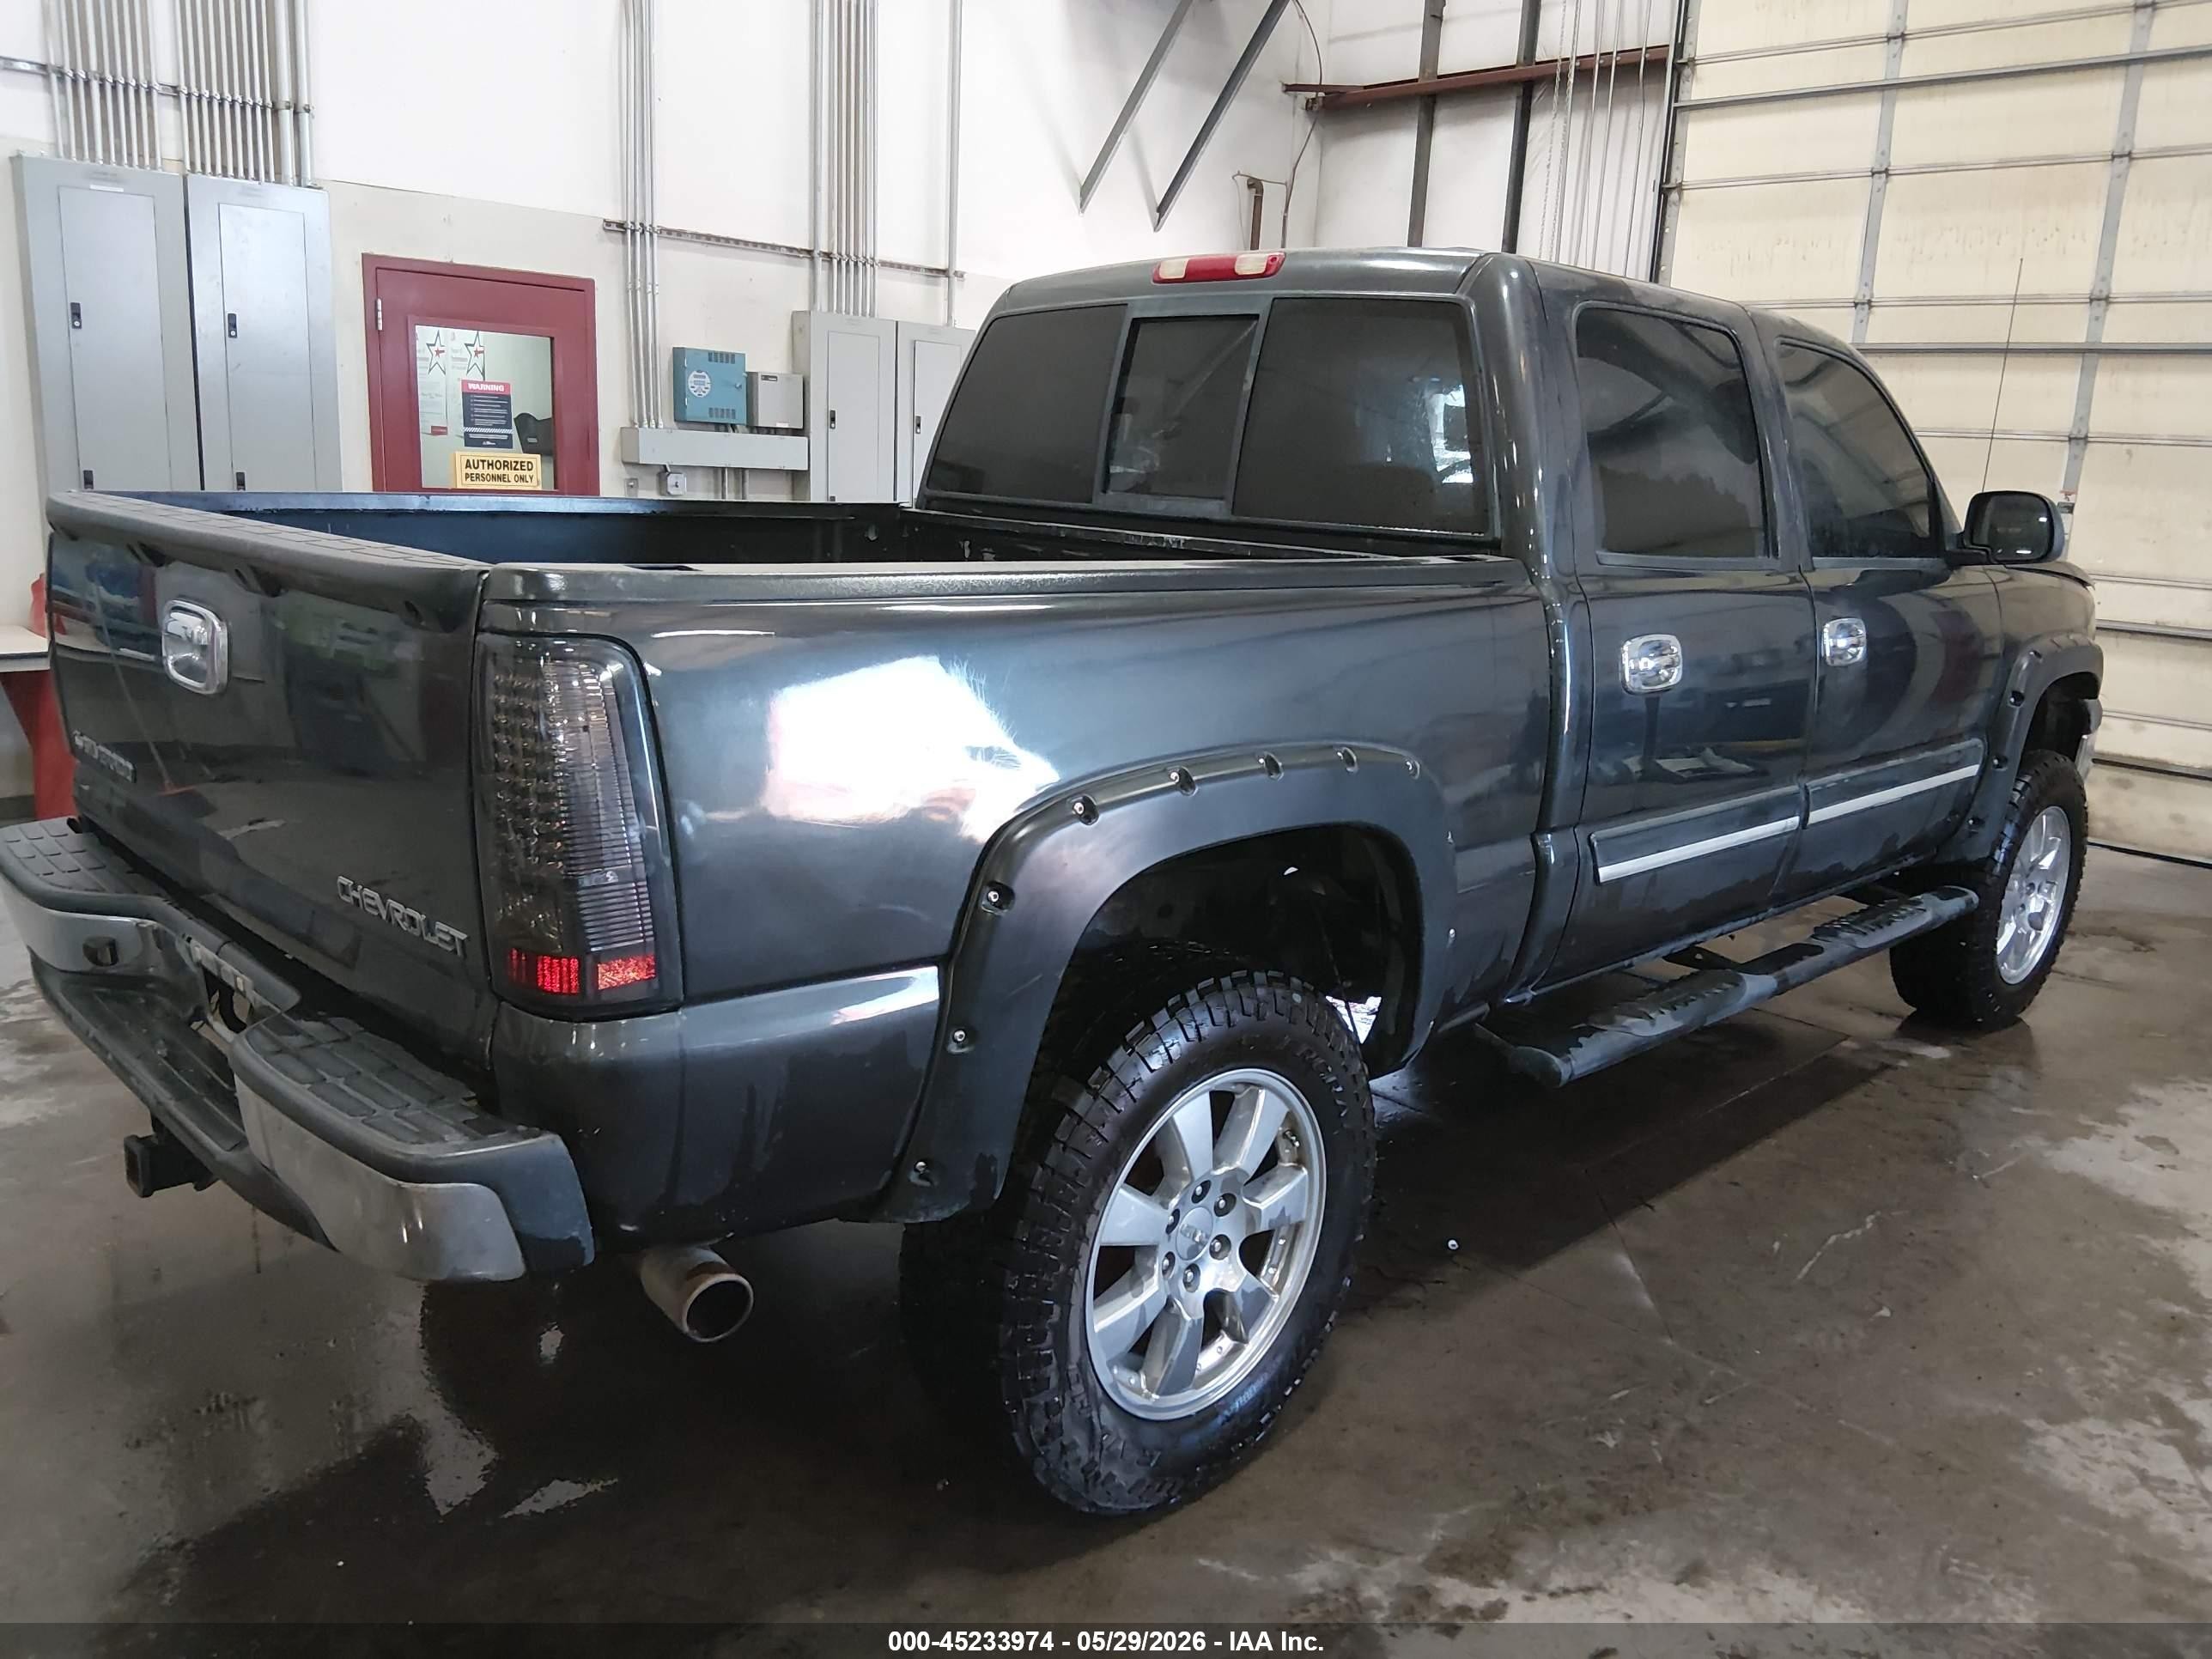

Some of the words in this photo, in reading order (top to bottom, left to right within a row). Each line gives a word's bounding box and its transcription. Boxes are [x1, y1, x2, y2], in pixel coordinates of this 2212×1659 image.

[467, 383, 505, 392] WARNING
[465, 459, 534, 471] AUTHORIZED
[465, 472, 511, 483] PERSONNEL
[514, 473, 534, 483] ONLY
[337, 875, 468, 957] CHEVROLET
